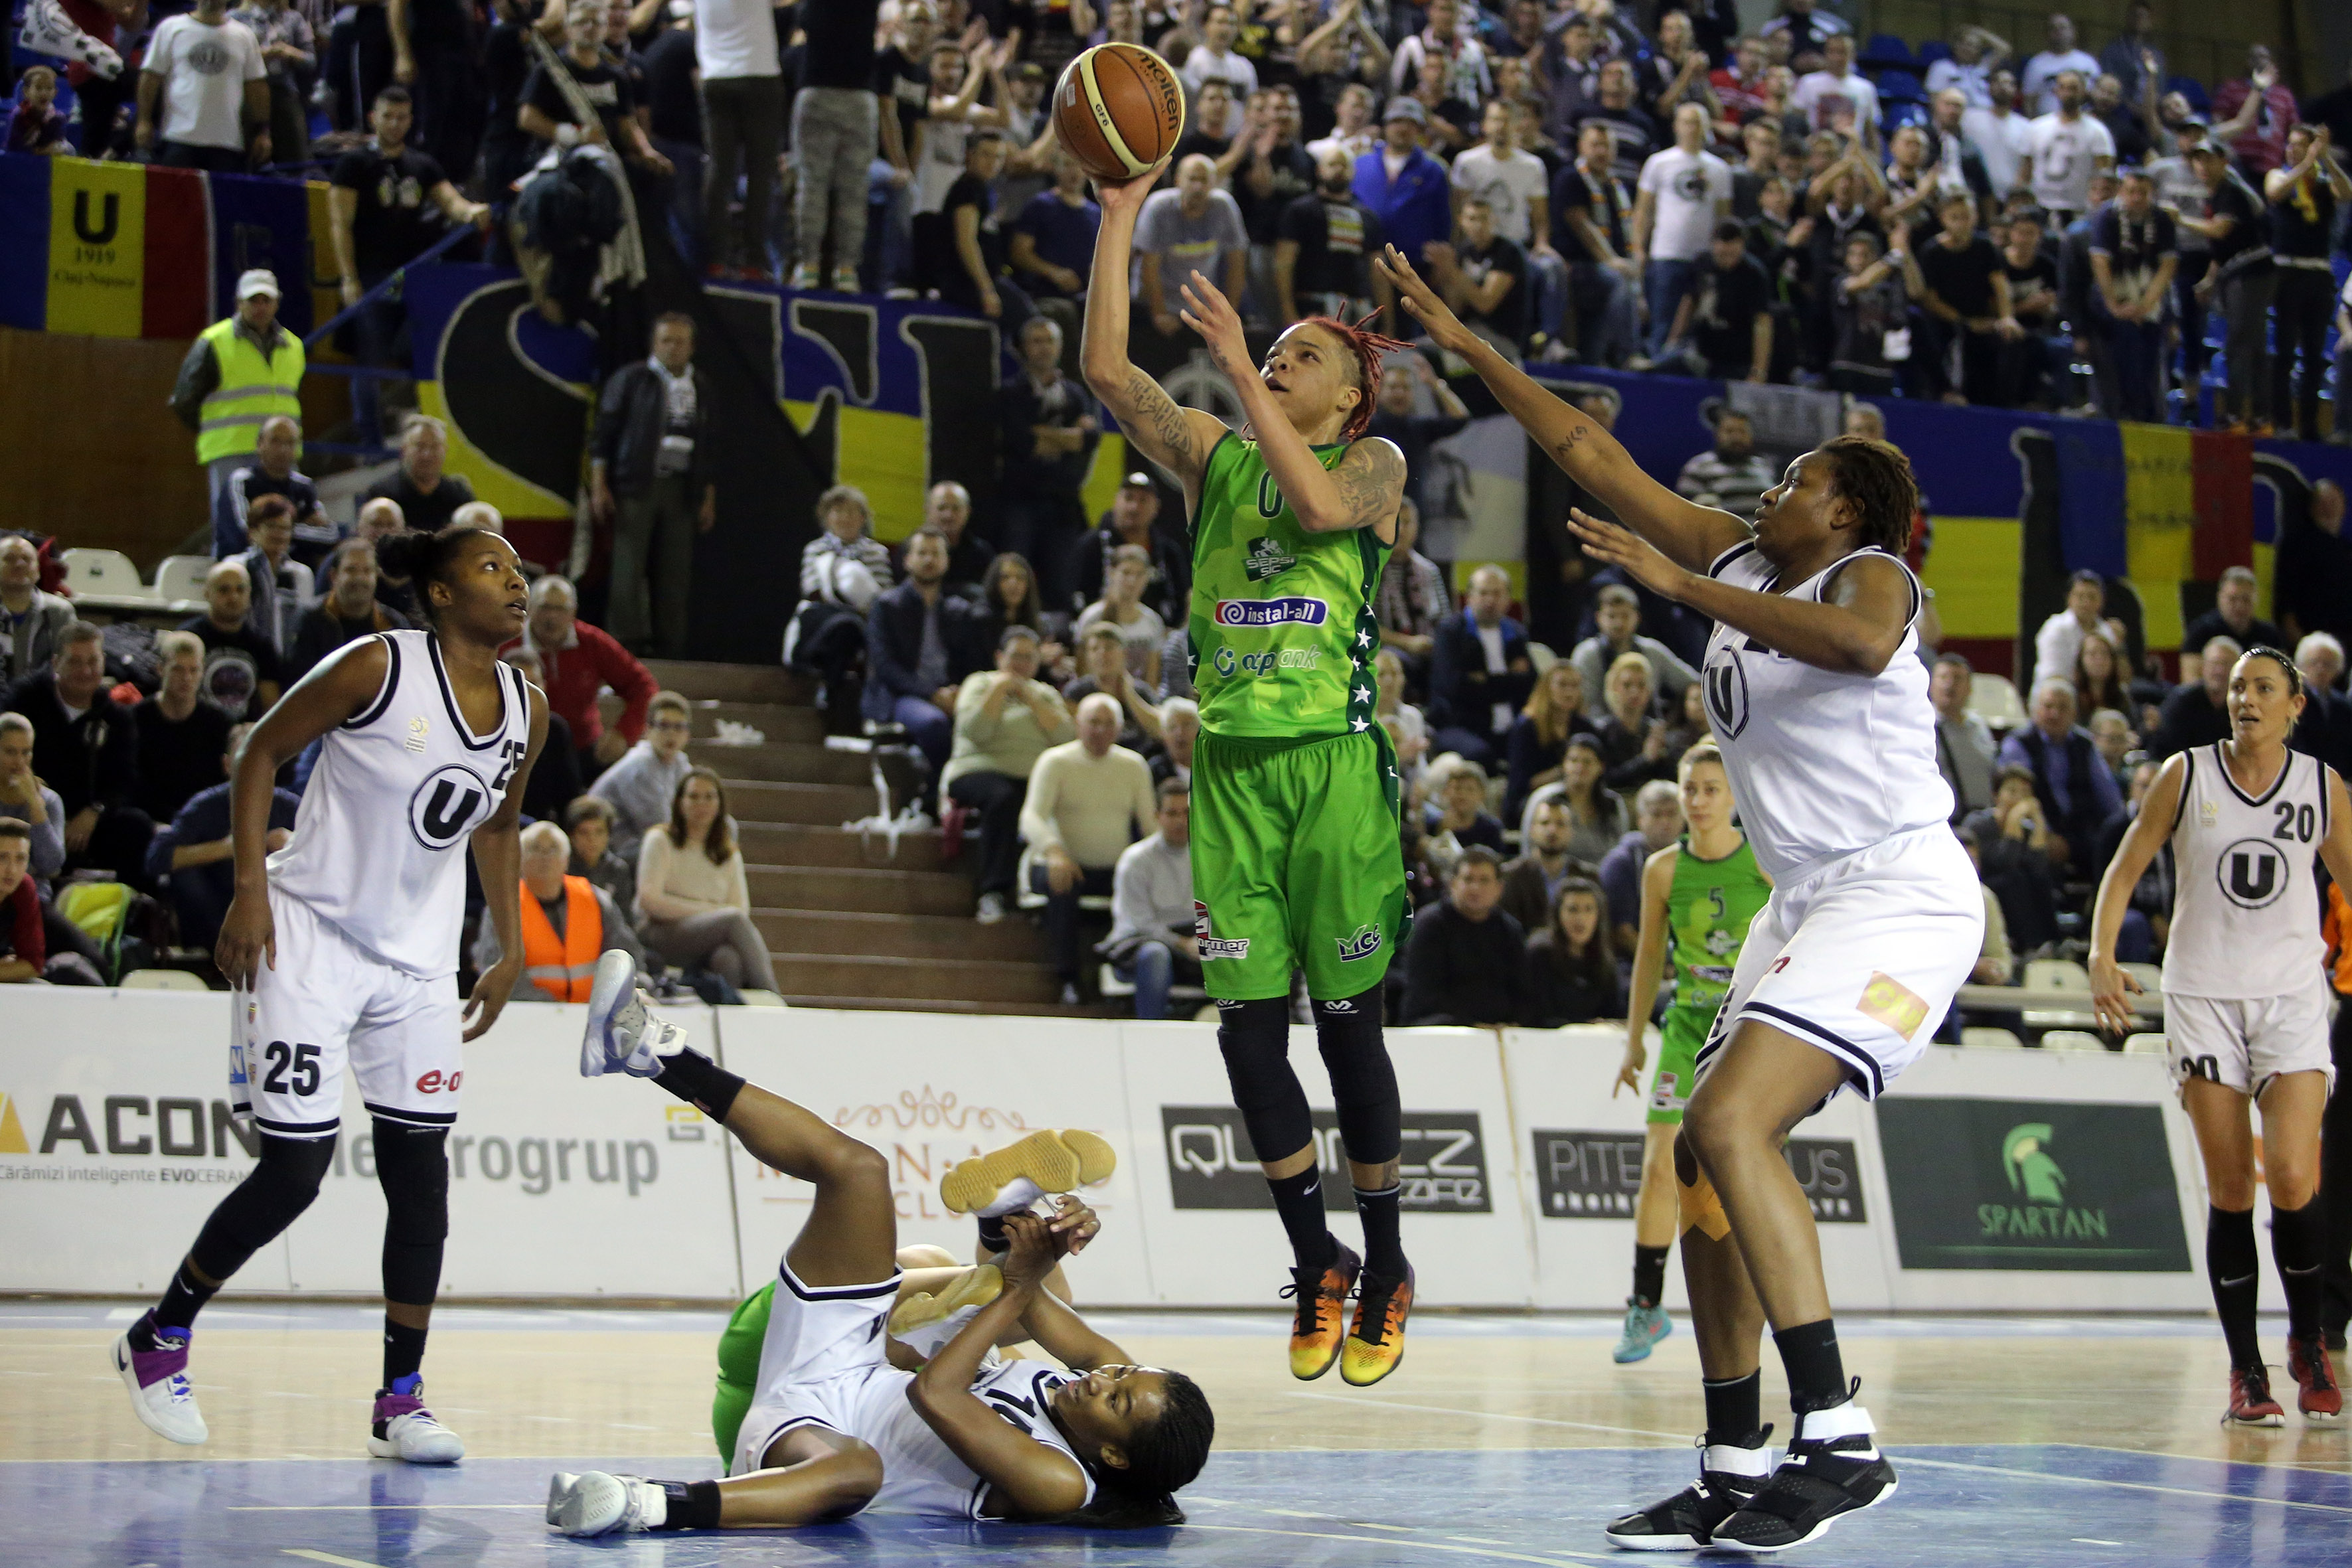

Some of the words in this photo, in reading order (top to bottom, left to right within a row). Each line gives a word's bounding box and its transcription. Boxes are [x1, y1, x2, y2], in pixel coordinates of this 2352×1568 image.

[1137, 52, 1179, 131] molten
[1095, 104, 1109, 127] GF6
[74, 190, 119, 244] U
[1245, 556, 1295, 569] SEPSI
[1260, 565, 1281, 577] SIC
[1247, 602, 1316, 623] instal-all
[423, 778, 483, 840] U
[2272, 801, 2315, 843] 20
[2231, 852, 2276, 900] U
[1708, 887, 1725, 919] 5
[264, 1040, 321, 1096] 25
[68, 1166, 155, 1184] inteligente
[1977, 1204, 2108, 1240] SPARTAN
